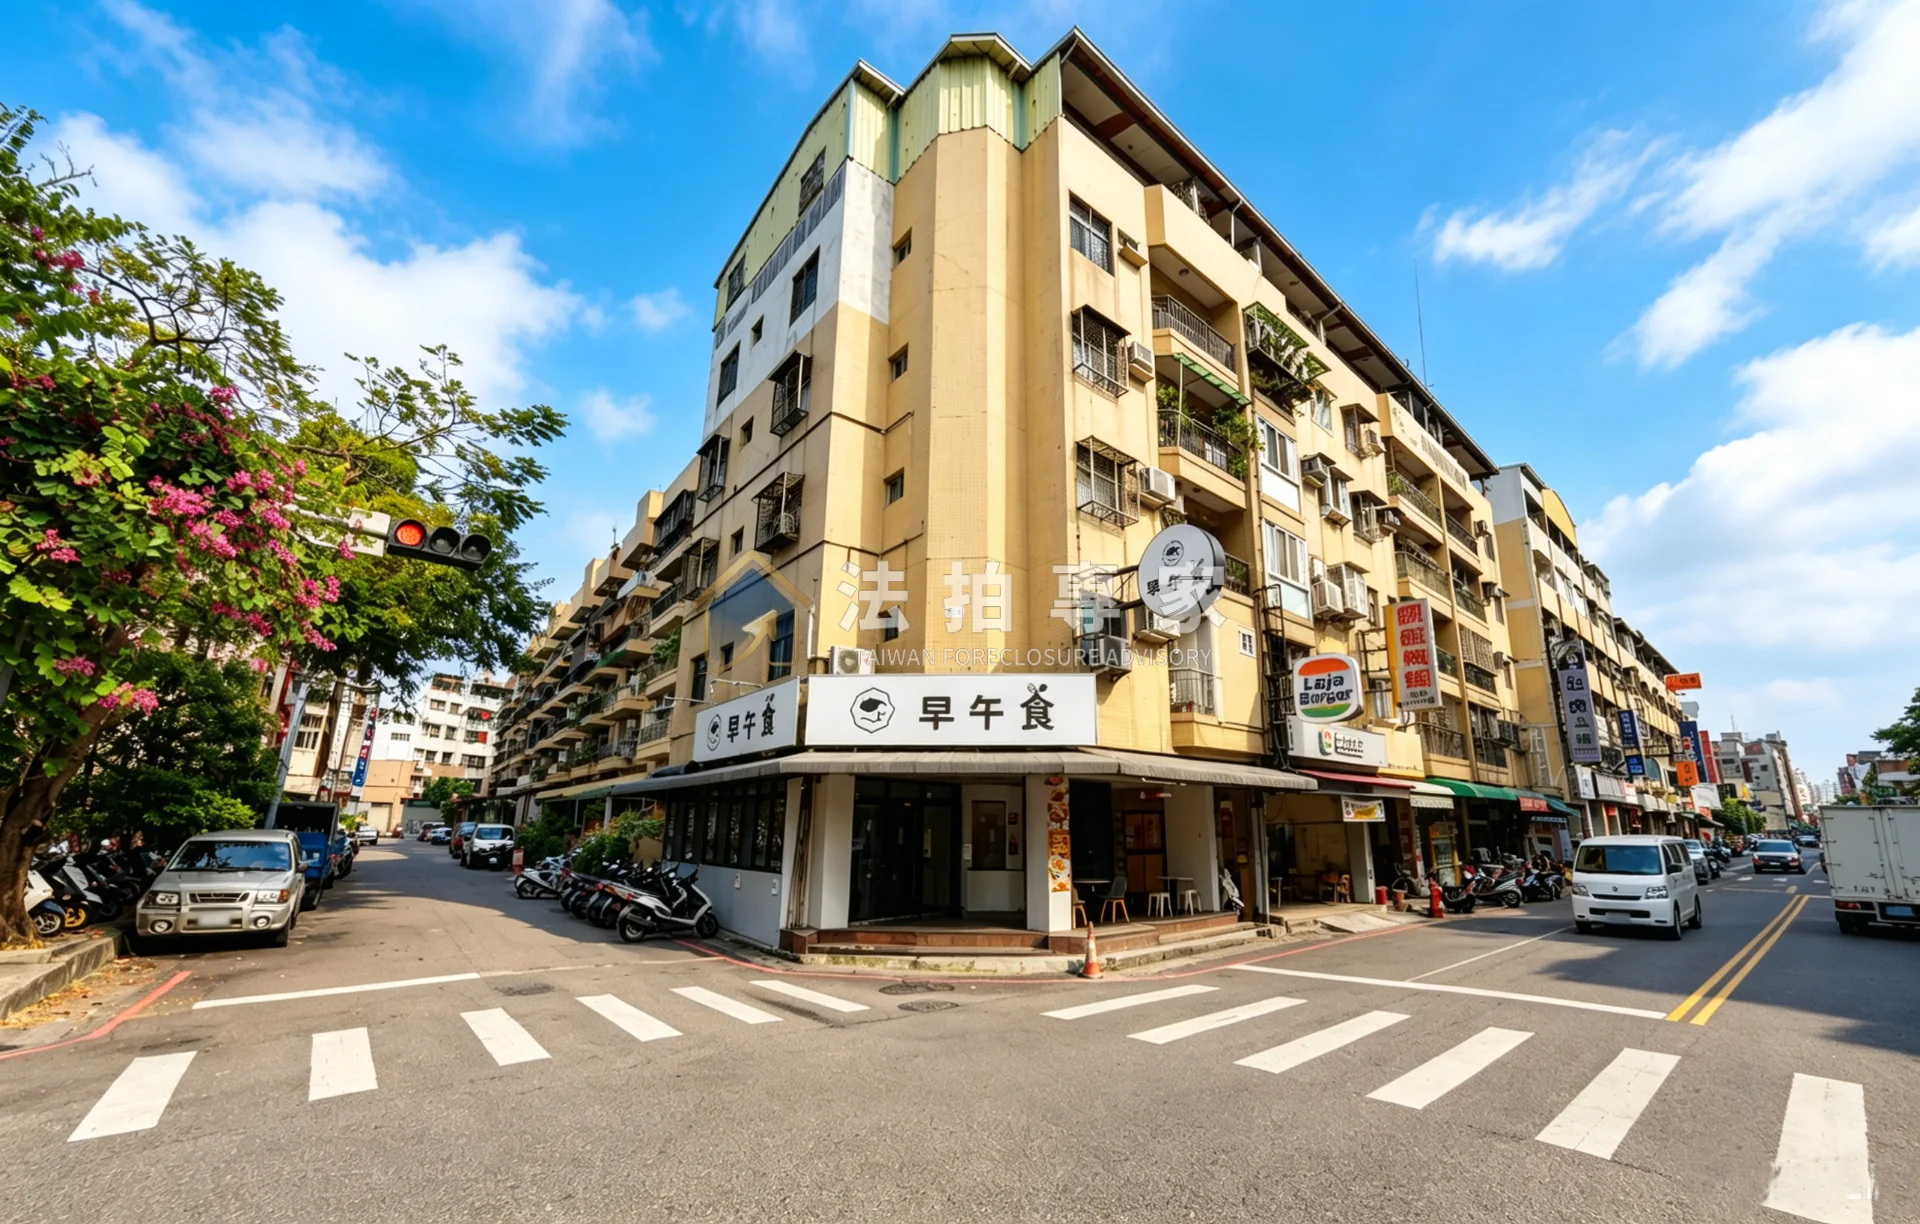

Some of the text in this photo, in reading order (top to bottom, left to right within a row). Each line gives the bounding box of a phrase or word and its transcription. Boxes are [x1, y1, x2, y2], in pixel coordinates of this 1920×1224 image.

[726, 694, 776, 744] 早午食
[918, 684, 1055, 731] 早午食
